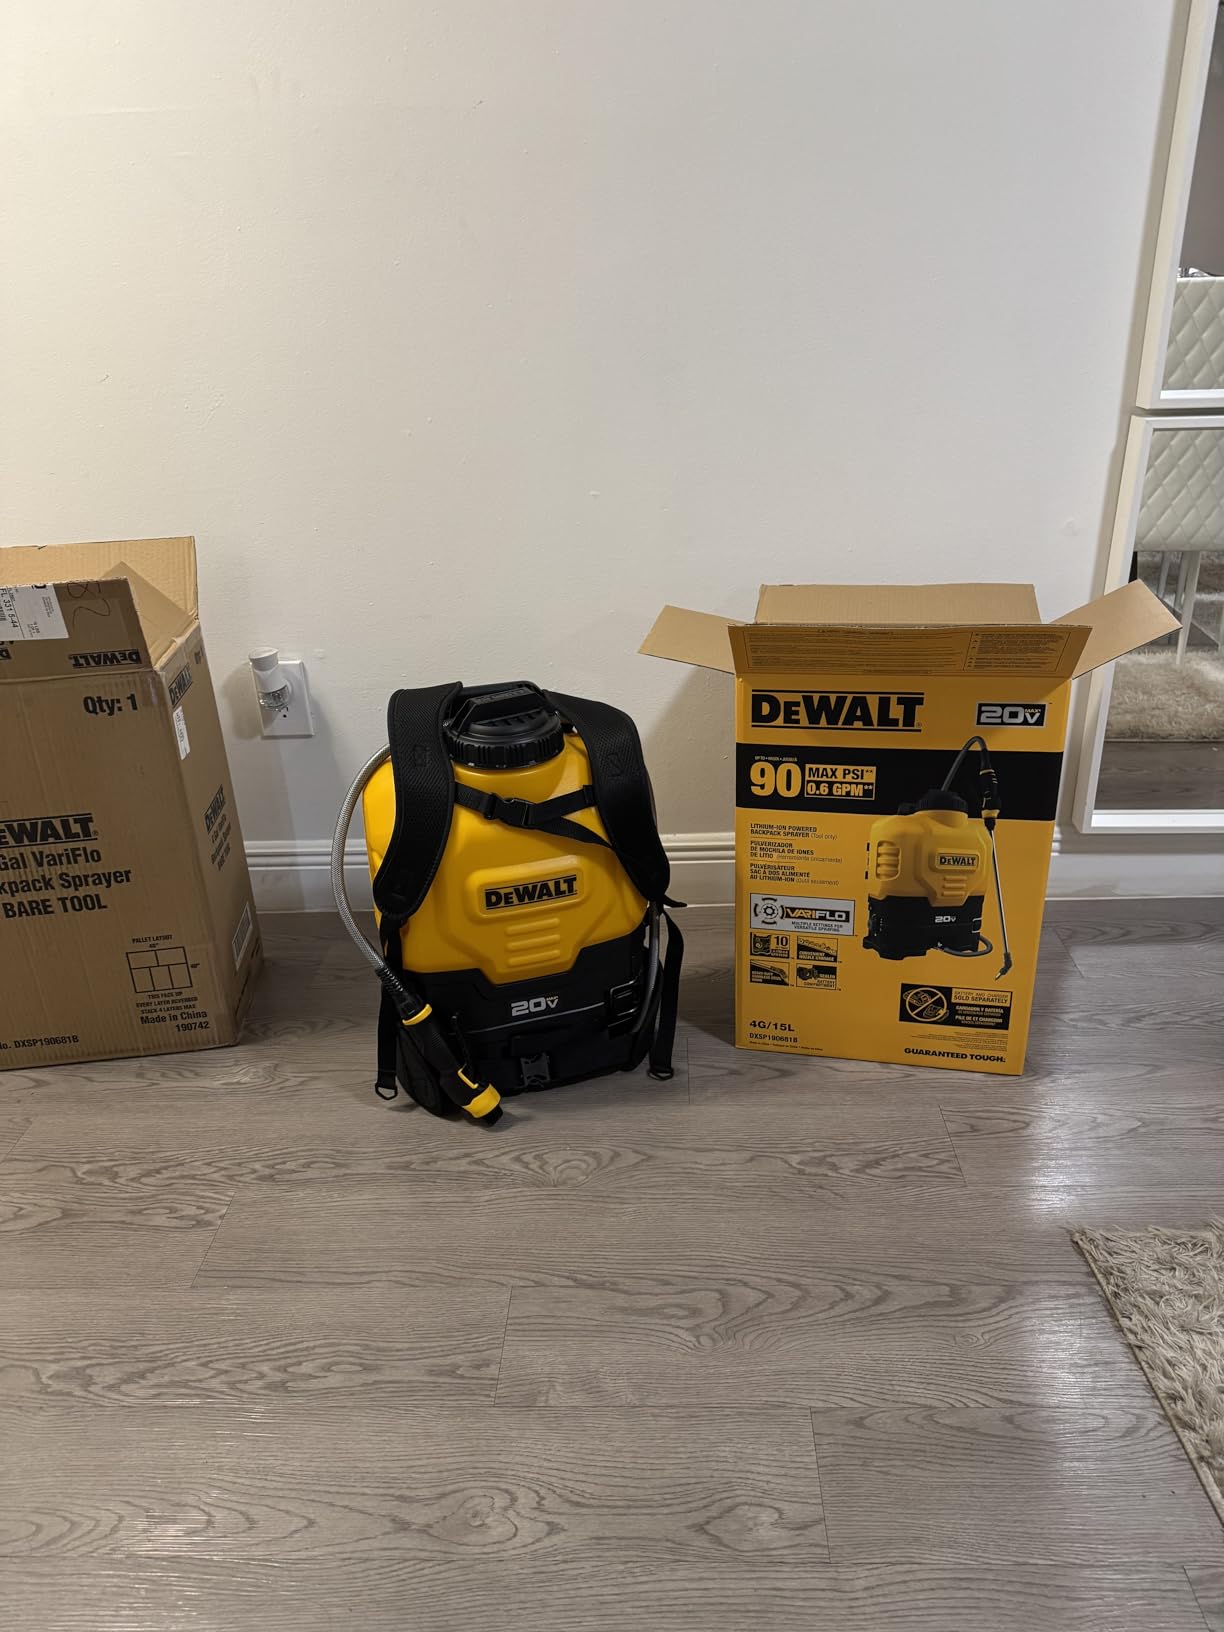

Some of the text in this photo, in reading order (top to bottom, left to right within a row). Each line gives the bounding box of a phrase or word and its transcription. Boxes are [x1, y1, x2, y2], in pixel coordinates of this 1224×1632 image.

[83, 694, 138, 716] Qty: 1
[752, 693, 924, 728] DEWALT
[751, 761, 801, 798] 90
[808, 768, 837, 779] MAX
[807, 783, 828, 795] 0.6
[0, 816, 94, 845] EWALT
[750, 823, 787, 831] LITHIUM-ION
[750, 840, 793, 849] PULVERIZADOR
[759, 846, 786, 854] MOCHILA
[31, 847, 102, 868] VariFlo
[940, 856, 977, 867] DEWALT
[0, 869, 132, 897] kpack Sprayer
[485, 876, 577, 908] DEWALT
[2, 893, 108, 919] BARE TOOL
[786, 907, 847, 921] VARIFLO
[774, 935, 789, 947] 10
[971, 996, 1009, 1004] SEPARATELY
[140, 1010, 208, 1025] Made in China
[176, 1021, 210, 1032] 190742
[749, 1020, 795, 1032] 4G/15L
[904, 1047, 968, 1060] GUARANTEED
